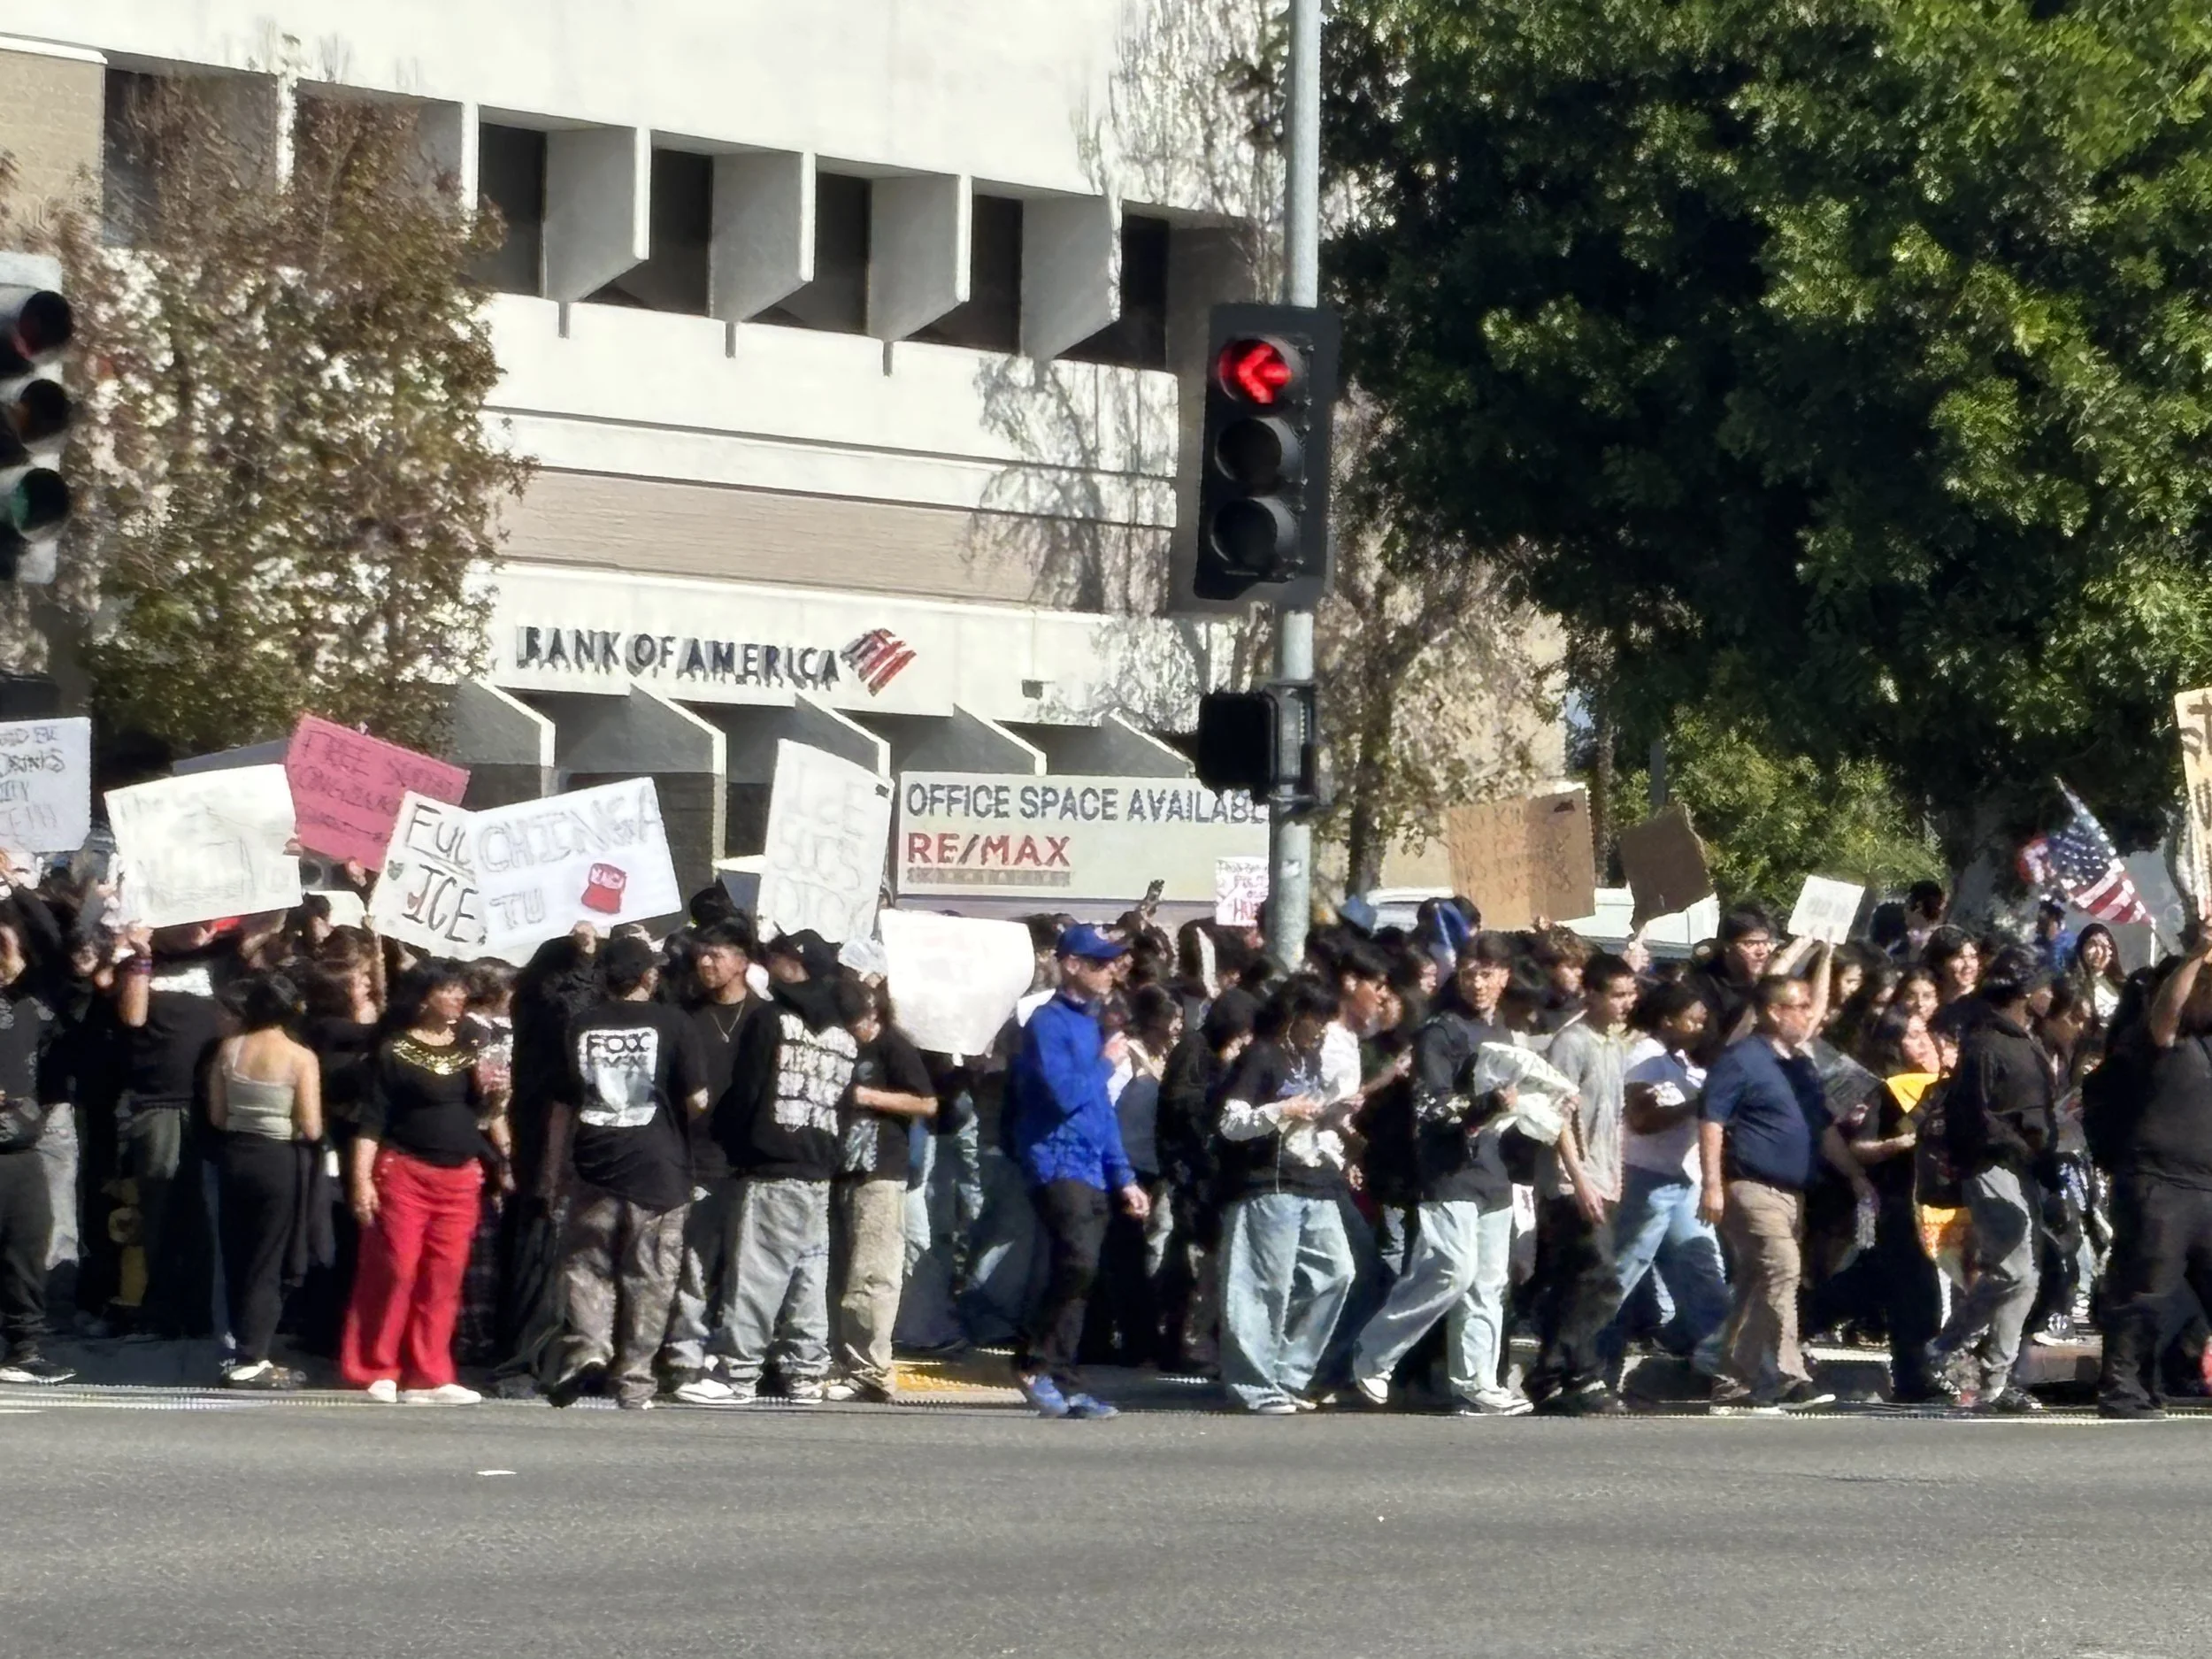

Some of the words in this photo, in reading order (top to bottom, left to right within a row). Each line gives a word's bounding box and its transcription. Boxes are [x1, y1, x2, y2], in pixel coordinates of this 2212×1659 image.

[516, 626, 620, 676] BANK
[625, 633, 676, 678] OF
[677, 637, 841, 692] AMERICA
[906, 783, 1010, 820] OFFICE
[1019, 785, 1119, 822] SPACE
[1127, 787, 1269, 825] AVAILABL
[404, 802, 472, 865] FUC
[908, 833, 1071, 867] RE/MAX
[488, 887, 546, 930] TU
